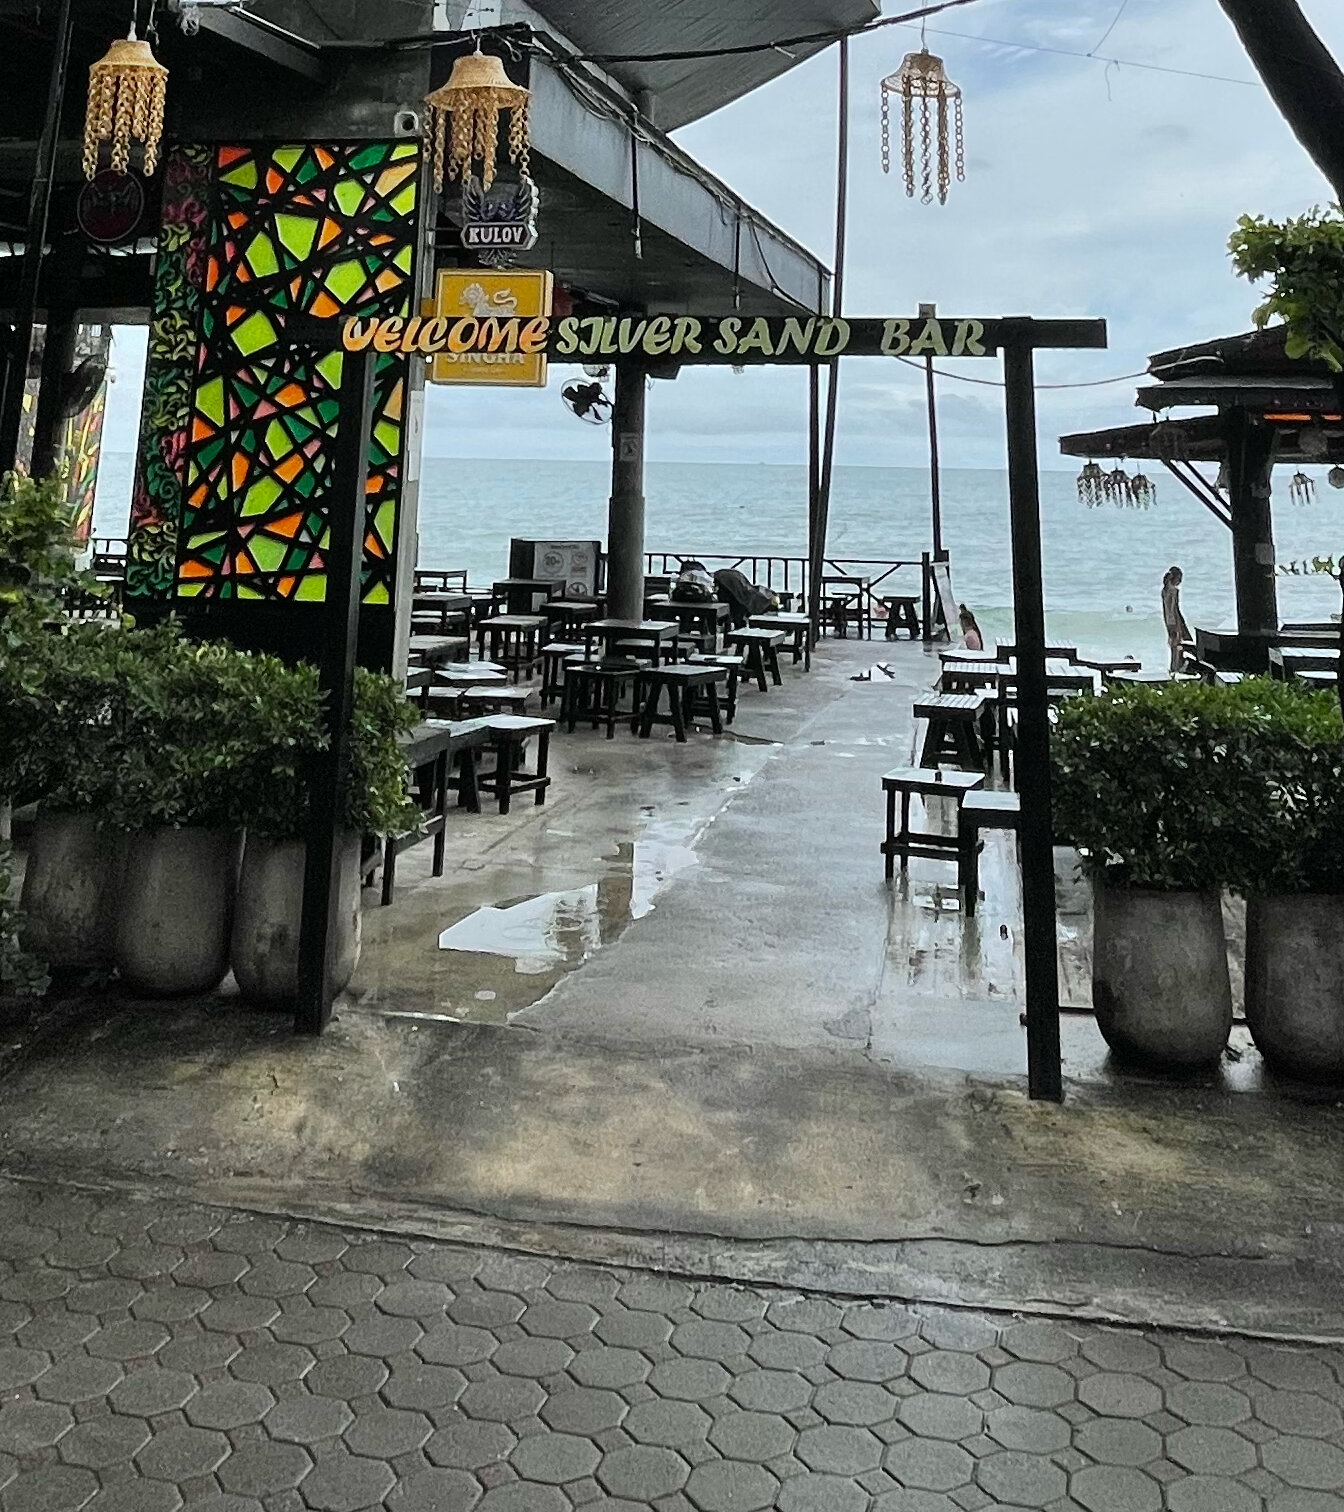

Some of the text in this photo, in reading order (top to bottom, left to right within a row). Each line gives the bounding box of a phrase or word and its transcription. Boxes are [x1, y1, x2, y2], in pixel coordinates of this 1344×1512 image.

[468, 226, 524, 244] KULOV
[341, 315, 986, 356] WELCOME SILVER SAND BAR
